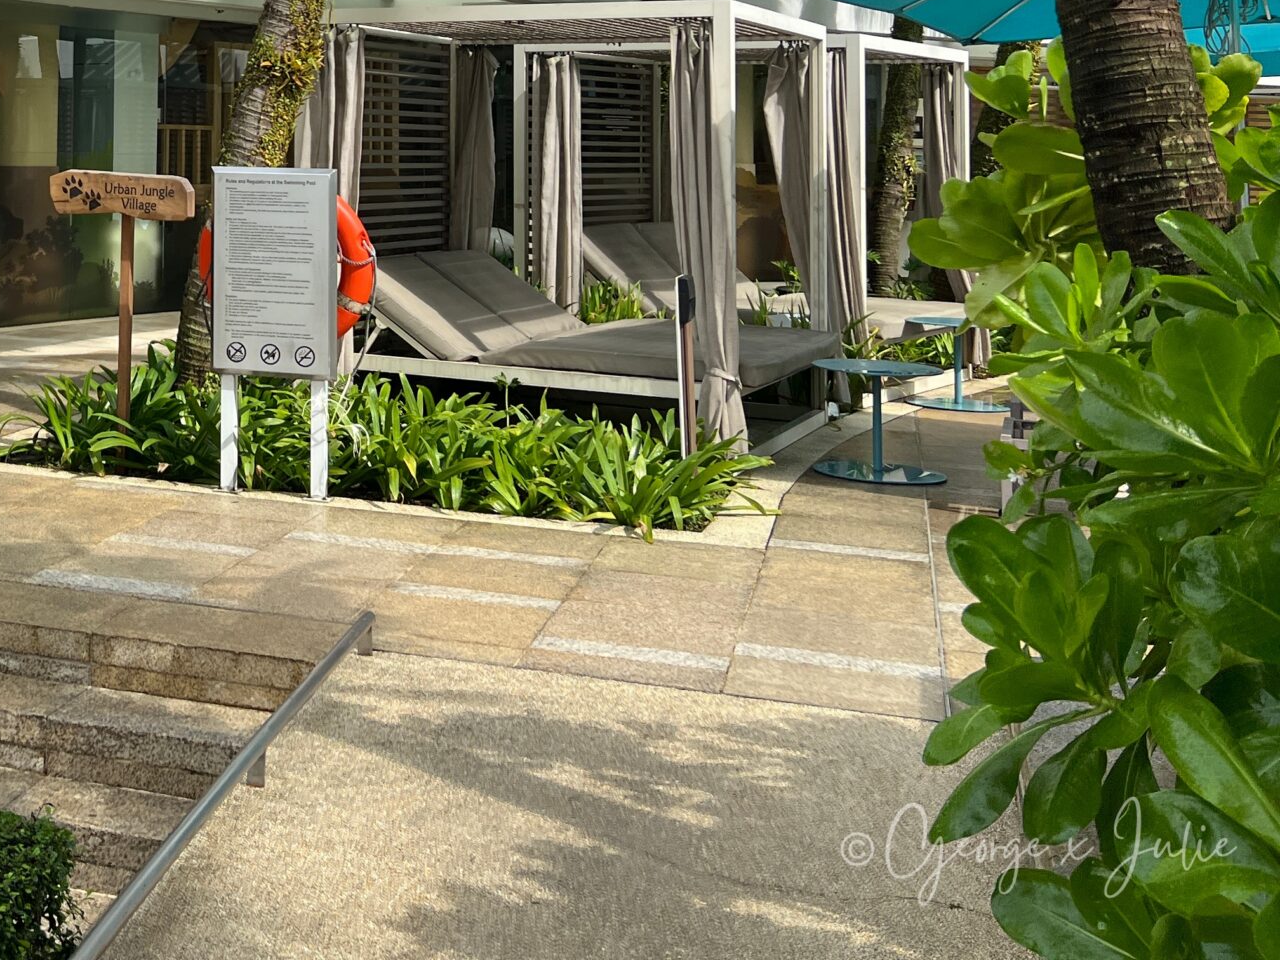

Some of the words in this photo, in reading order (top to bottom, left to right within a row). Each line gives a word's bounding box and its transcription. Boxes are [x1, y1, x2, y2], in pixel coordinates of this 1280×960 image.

[104, 182, 137, 196] Urban
[140, 184, 175, 200] Jungle
[121, 197, 157, 214] Village
